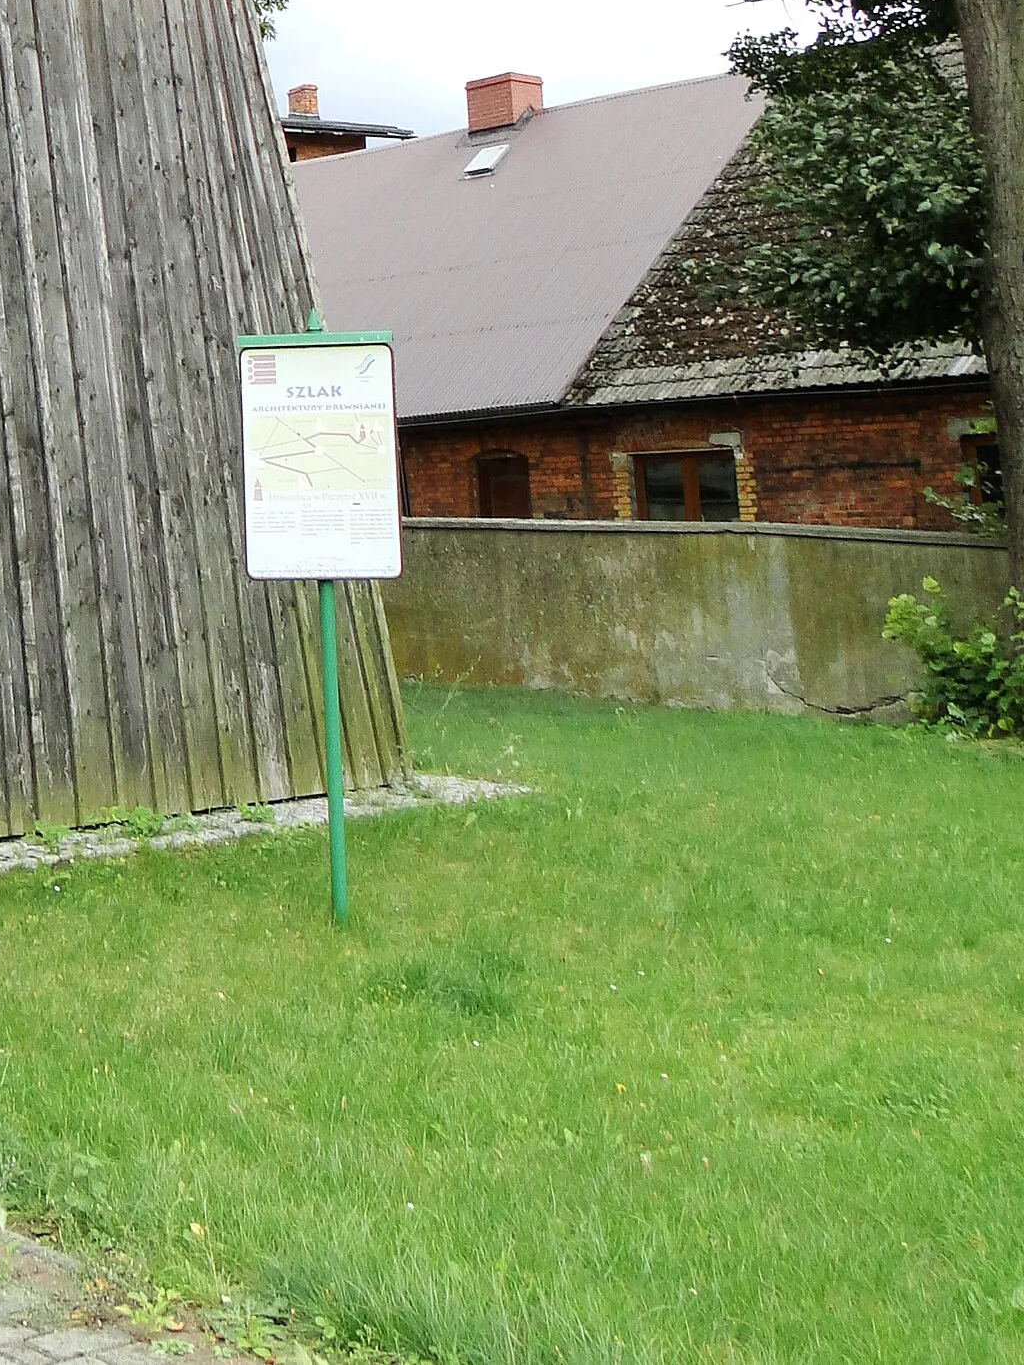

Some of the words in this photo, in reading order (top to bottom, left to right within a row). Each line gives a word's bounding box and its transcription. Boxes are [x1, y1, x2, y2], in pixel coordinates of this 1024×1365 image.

[286, 385, 342, 399] SZLAK
[251, 403, 323, 412] ARCHITEKTURY
[325, 402, 386, 411] DREWNIANEJ
